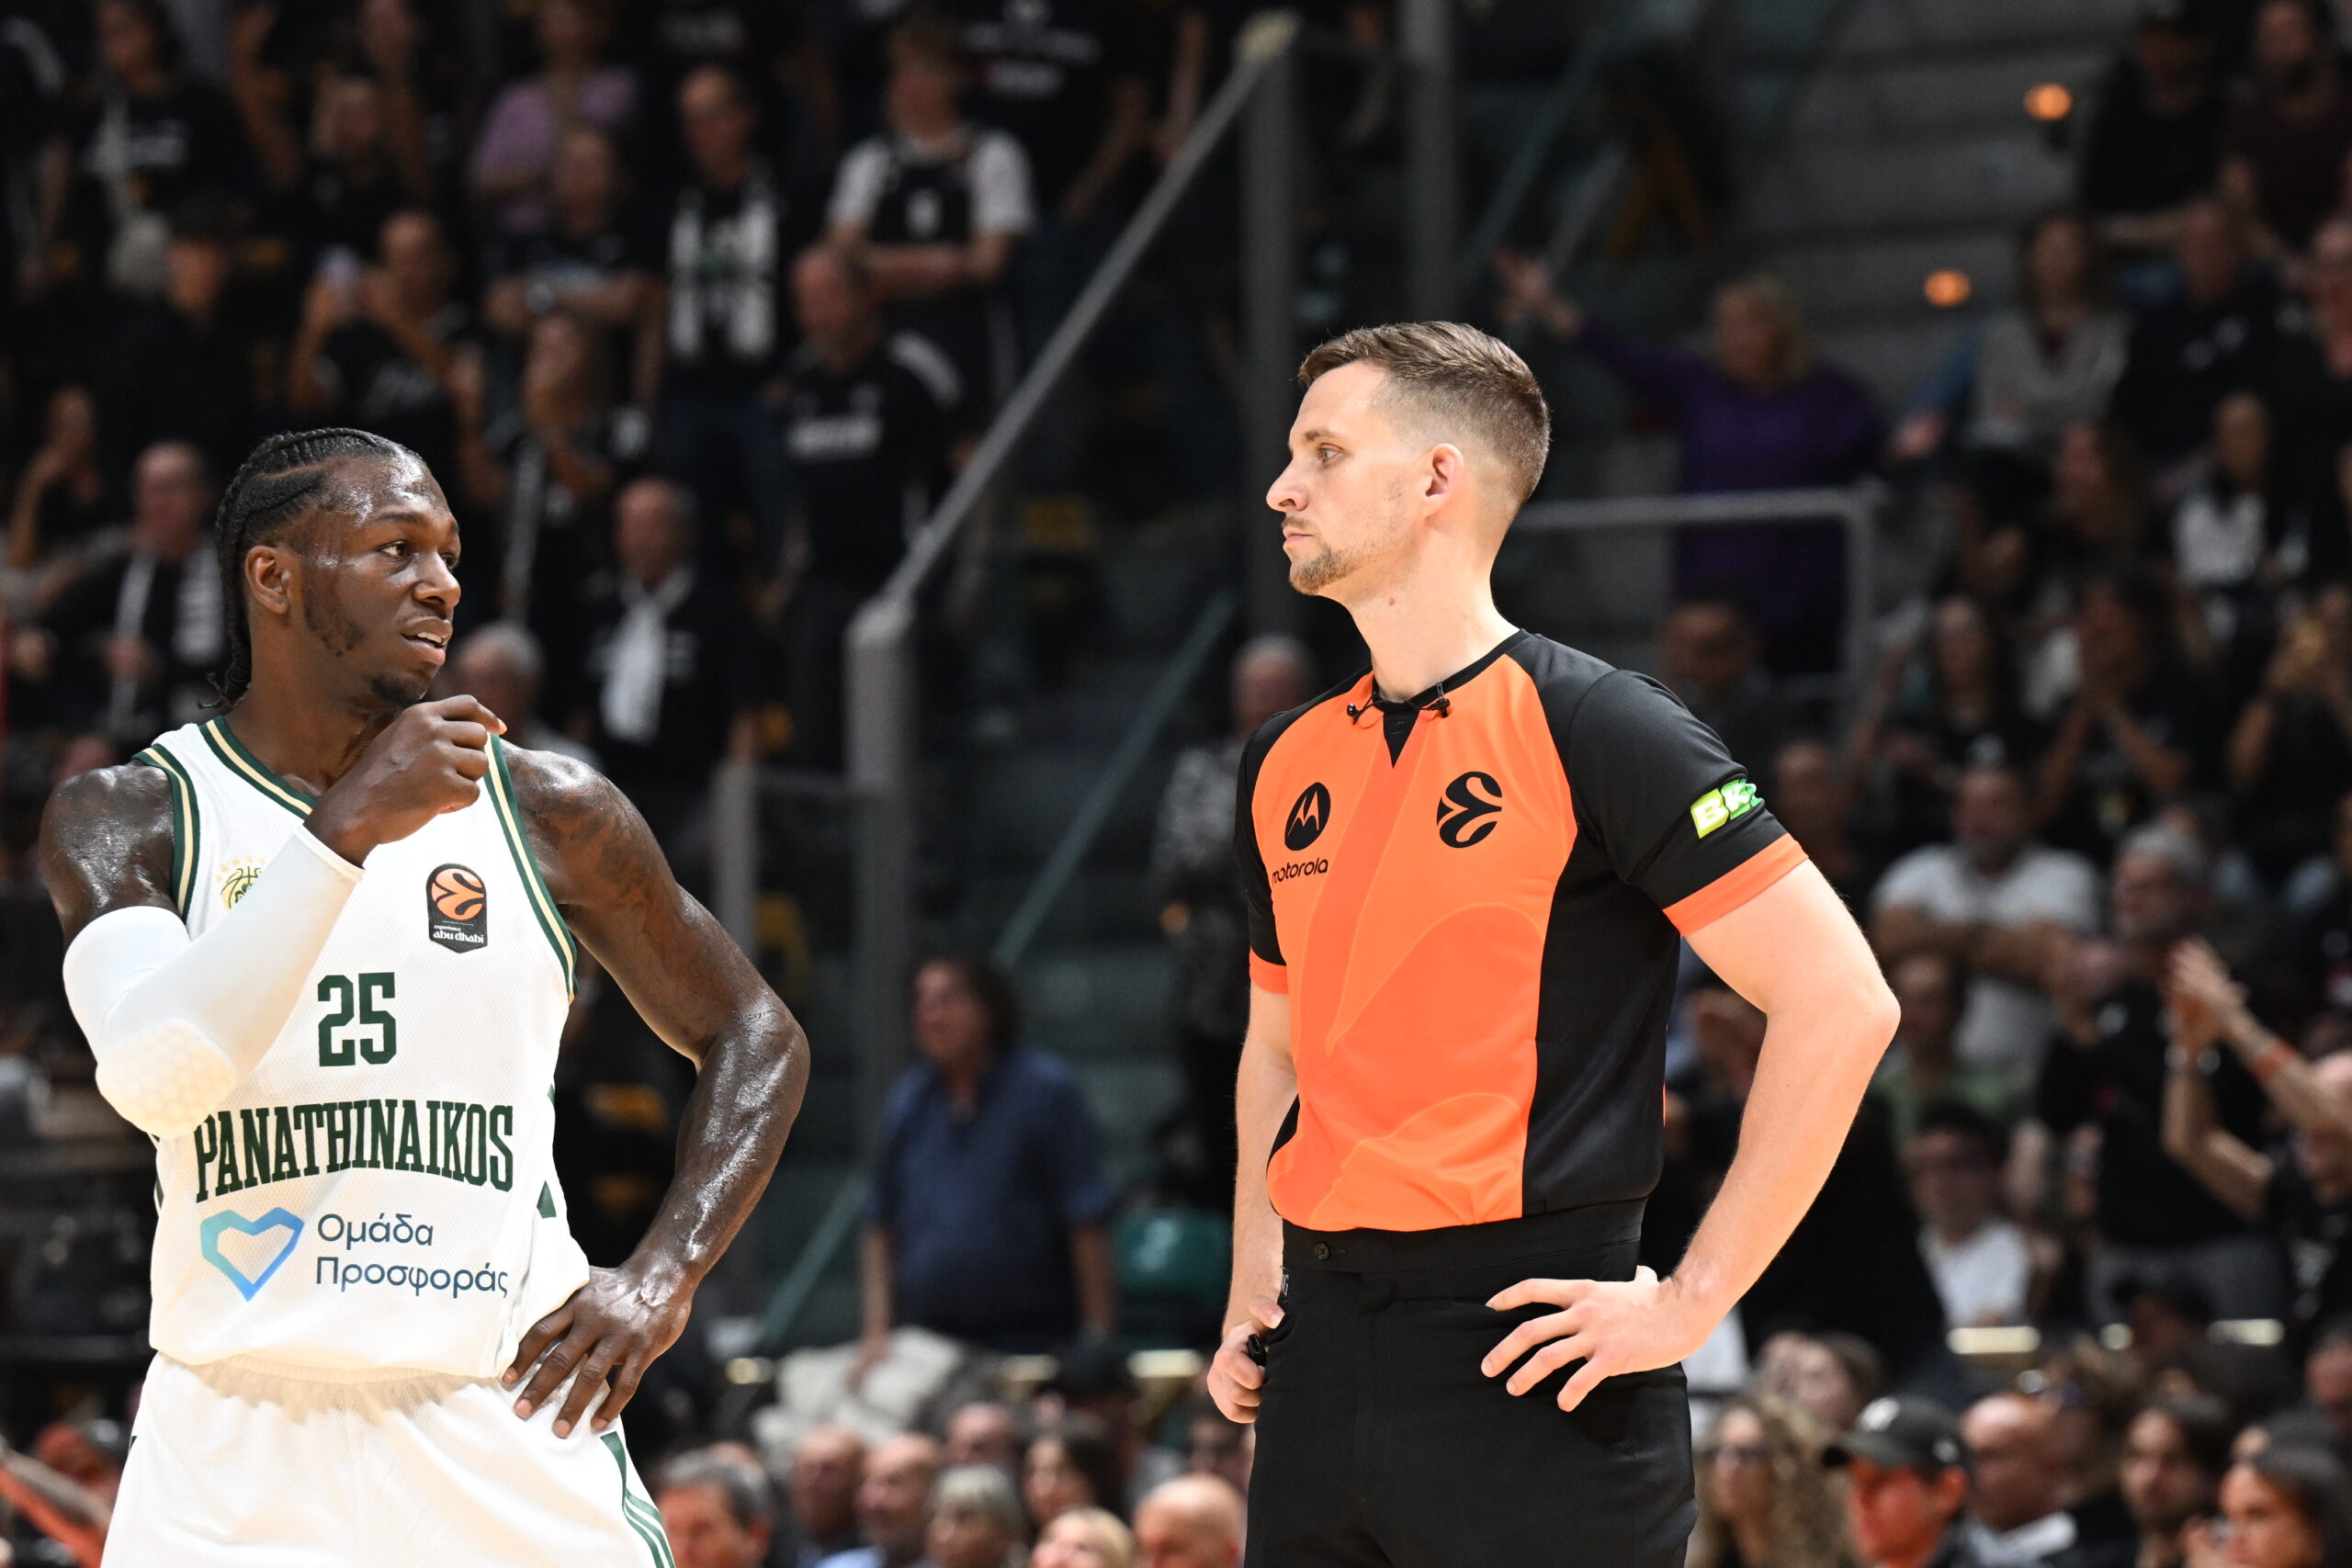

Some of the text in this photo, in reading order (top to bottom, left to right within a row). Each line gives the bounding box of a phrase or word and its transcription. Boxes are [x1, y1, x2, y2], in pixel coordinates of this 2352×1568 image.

[1272, 857, 1329, 886] motorola
[434, 931, 485, 944] abu dhabi
[317, 972, 397, 1066] 25
[194, 1099, 514, 1203] PANATHINAIKOS
[317, 1213, 434, 1250] Ομάδα
[316, 1256, 508, 1299] Προσφοράς
